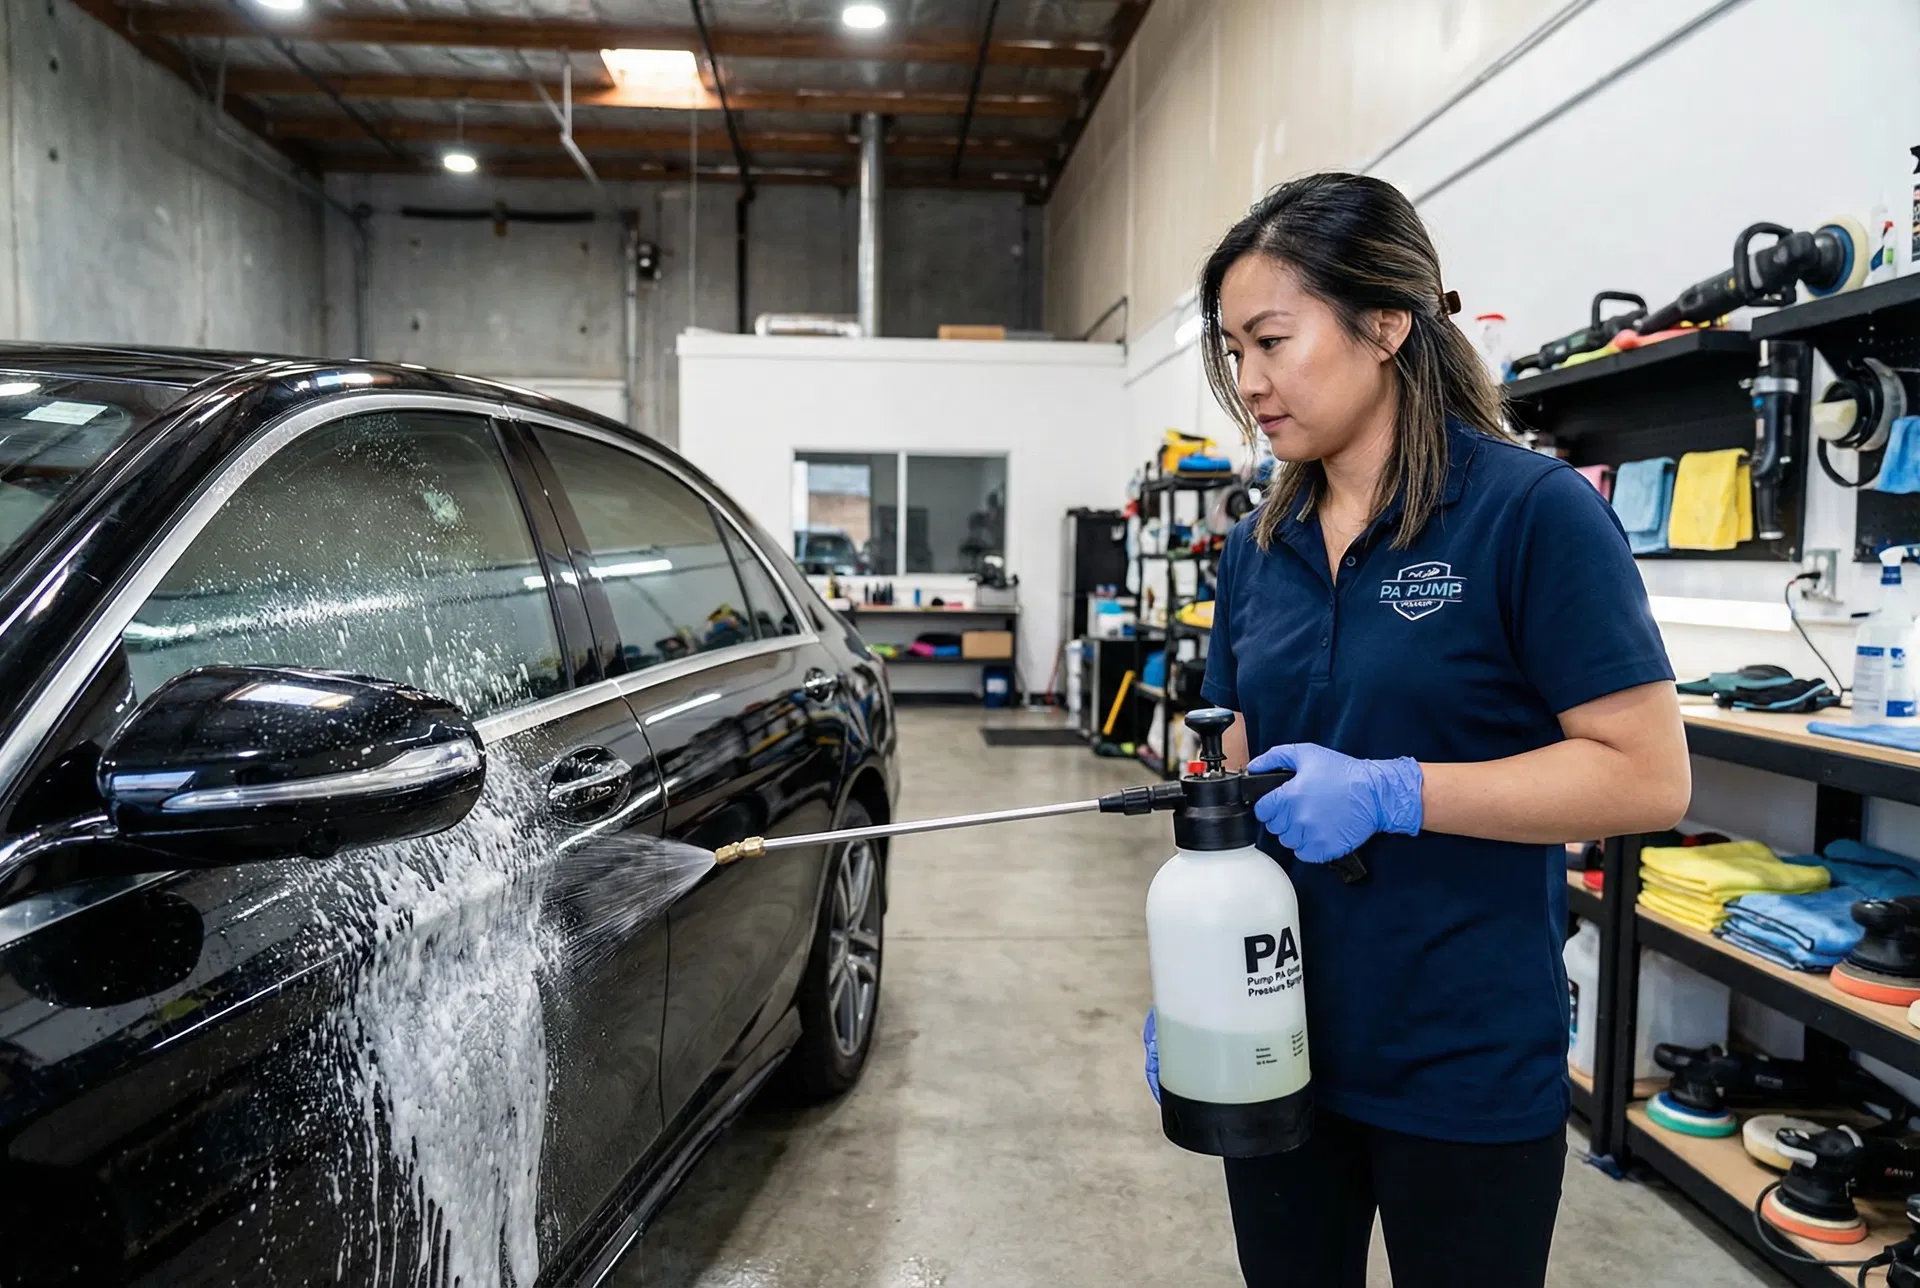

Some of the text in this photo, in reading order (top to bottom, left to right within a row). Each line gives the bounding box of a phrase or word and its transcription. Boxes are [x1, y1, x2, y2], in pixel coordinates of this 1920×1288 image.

[1380, 582, 1462, 599] PA PUMP
[1244, 926, 1299, 974] PA
[1247, 975, 1274, 986] Pump
